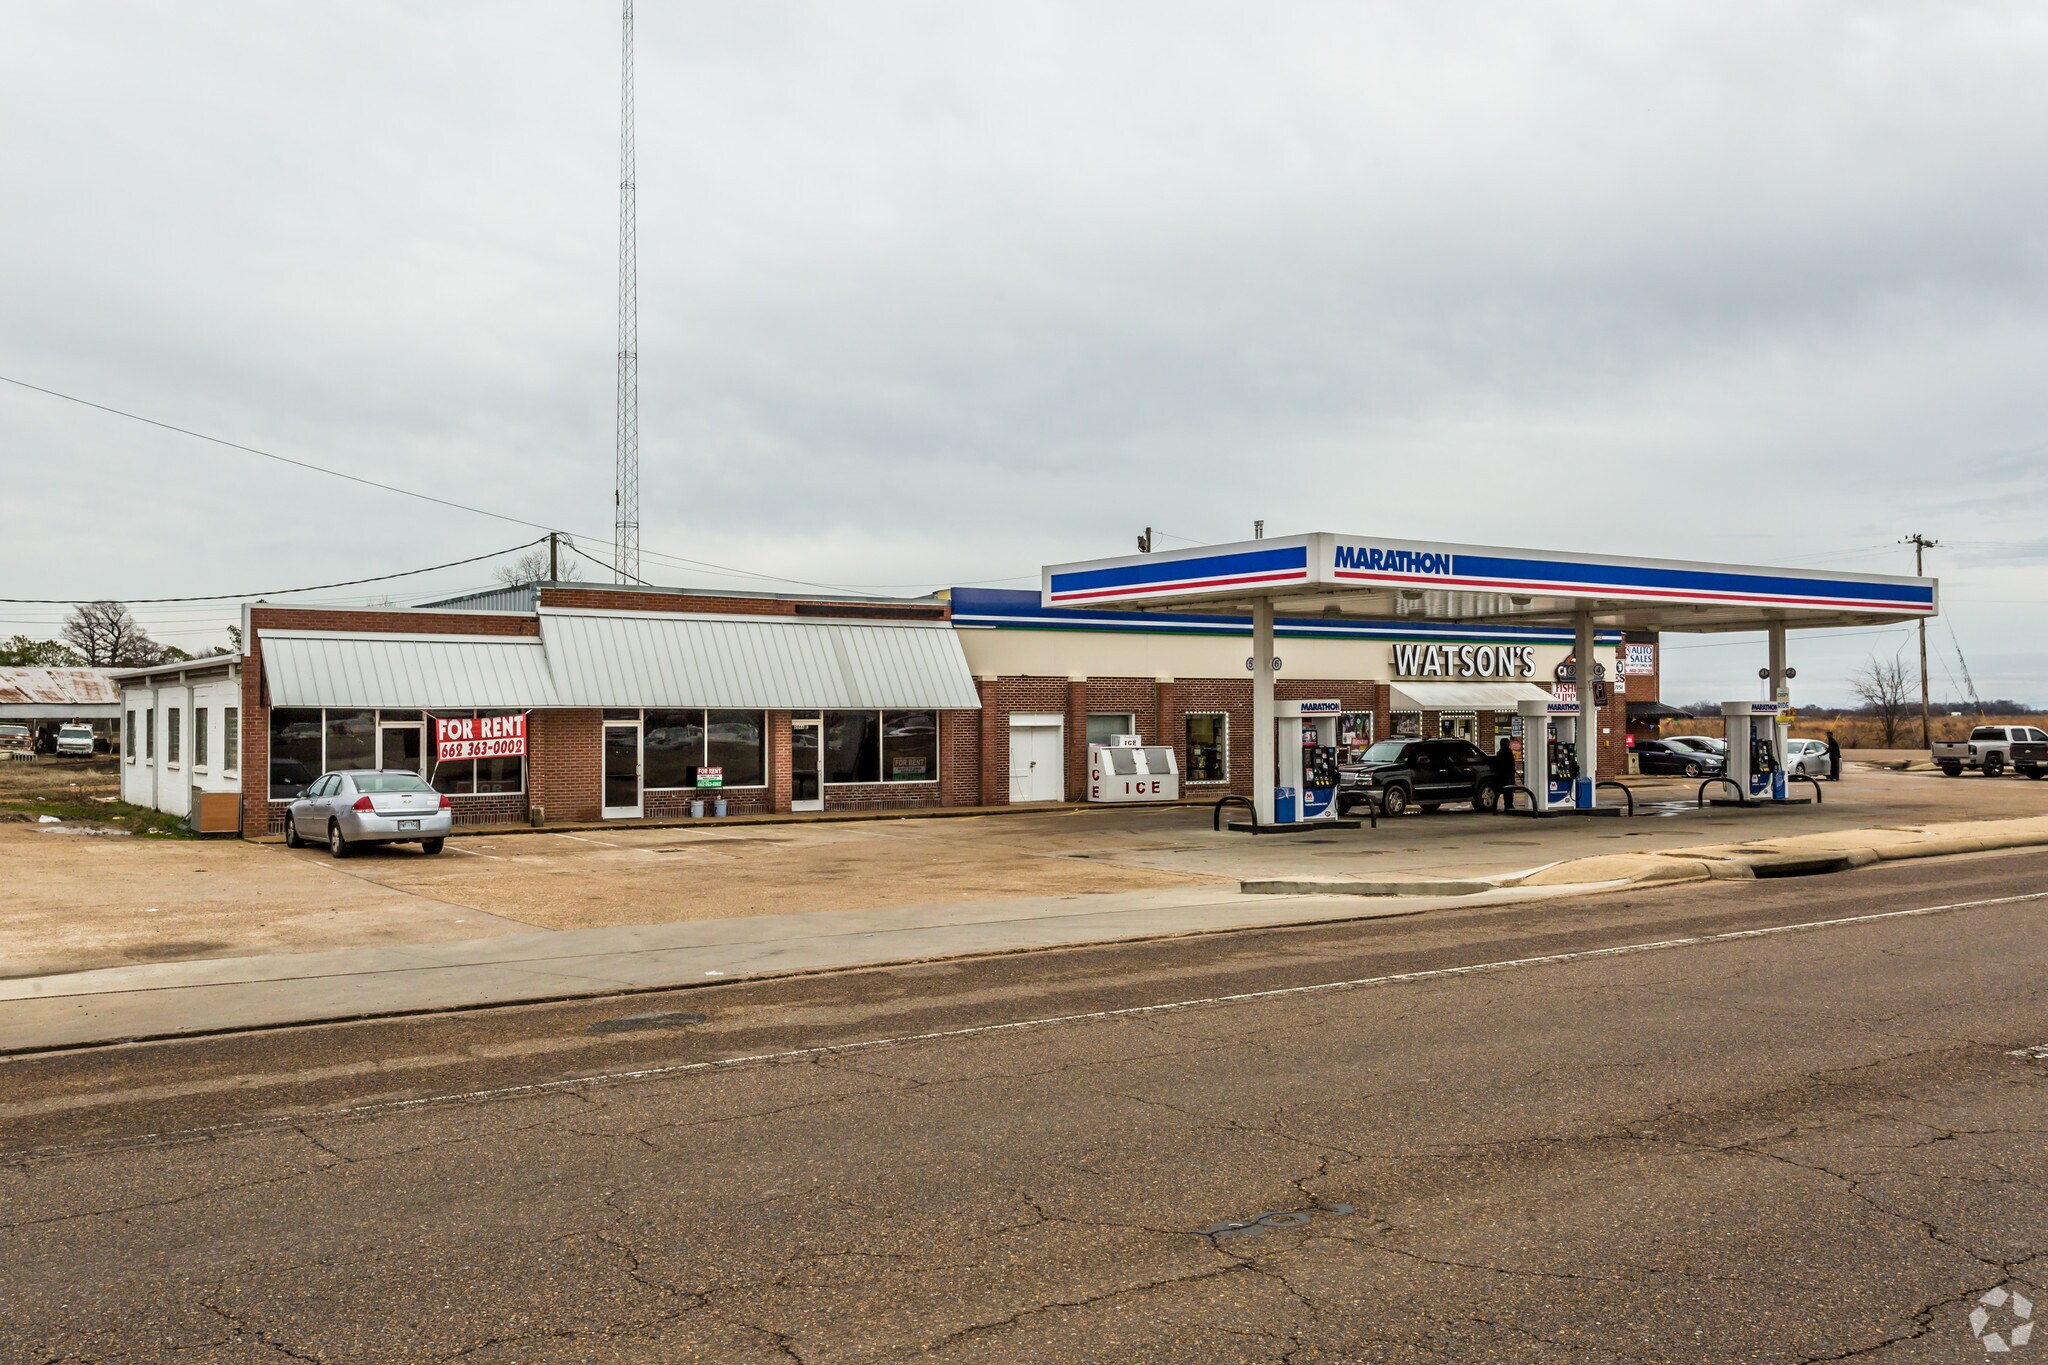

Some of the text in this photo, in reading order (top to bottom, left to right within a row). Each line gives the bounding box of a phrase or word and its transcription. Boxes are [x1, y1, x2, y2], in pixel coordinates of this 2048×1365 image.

[1334, 546, 1450, 575] MARATHON
[1631, 646, 1653, 655] AUTO
[1392, 644, 1536, 678] WATSON'S
[1630, 654, 1653, 663] SALES
[1301, 703, 1340, 711] MARATHON
[1547, 703, 1580, 711] MARATHON
[1751, 703, 1777, 711] MARATHON
[438, 715, 524, 741] FOR RENT
[441, 739, 523, 758] 662 363-0002
[895, 758, 924, 767] FOR RENT
[1092, 751, 1100, 799] ICE
[1125, 780, 1161, 795] ICE
